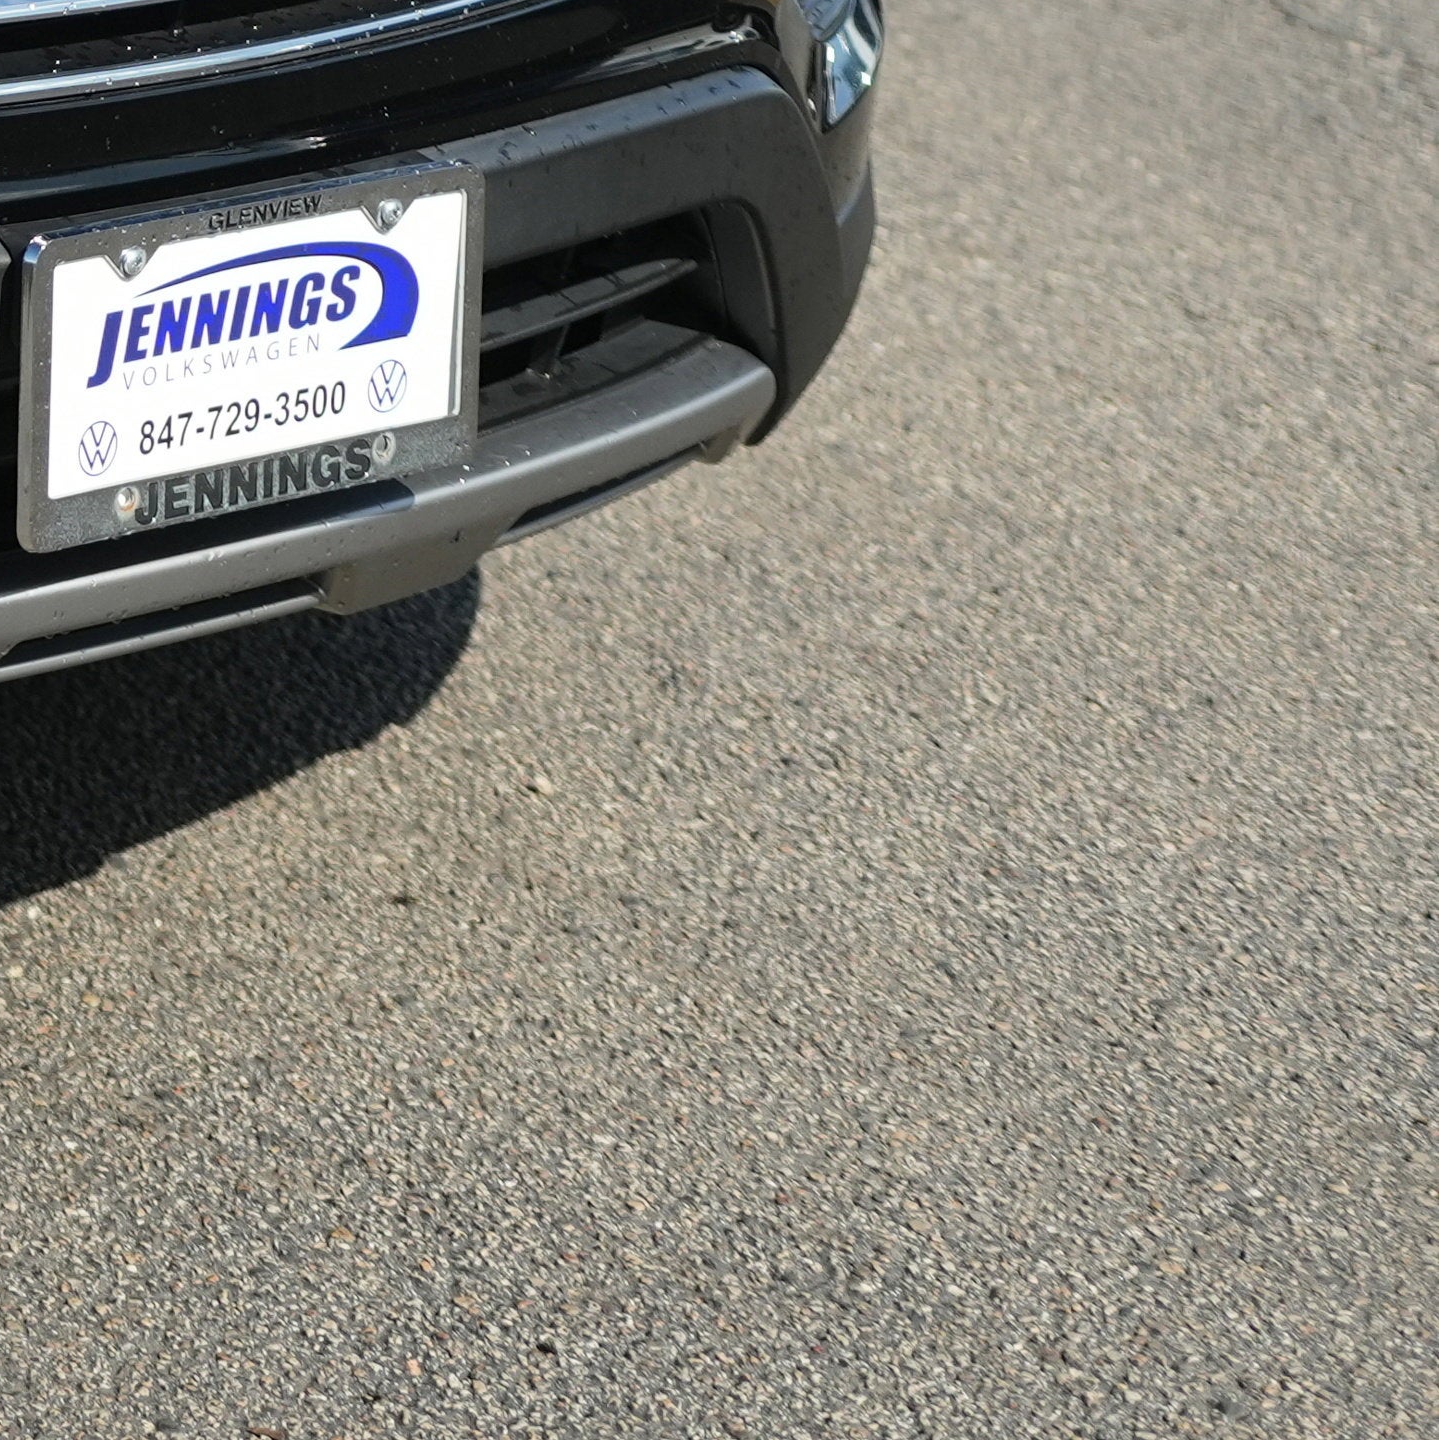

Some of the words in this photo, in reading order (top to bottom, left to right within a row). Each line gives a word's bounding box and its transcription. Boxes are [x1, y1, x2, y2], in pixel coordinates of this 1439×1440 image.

[208, 194, 322, 231] GLENVIEW
[86, 264, 361, 390] JENNINGS
[122, 332, 321, 391] VOLKSWAGEN
[139, 380, 347, 456] 847-729-3500
[134, 438, 372, 526] JENNINGS
